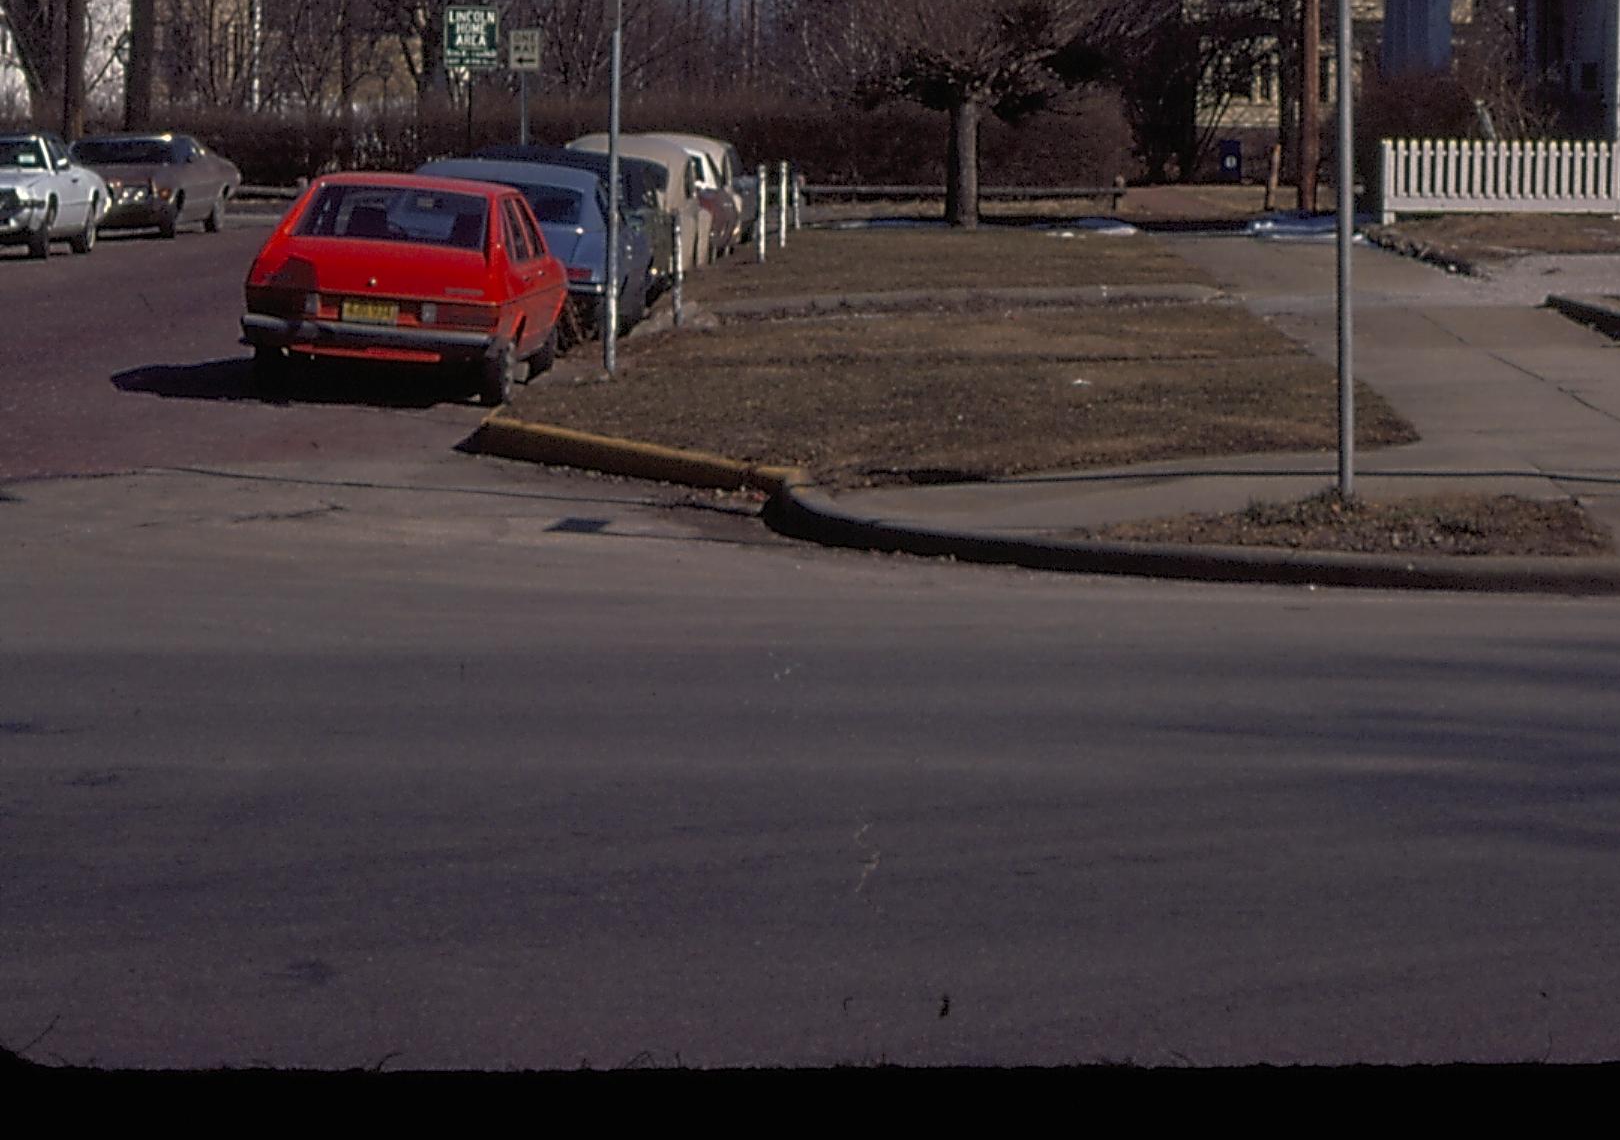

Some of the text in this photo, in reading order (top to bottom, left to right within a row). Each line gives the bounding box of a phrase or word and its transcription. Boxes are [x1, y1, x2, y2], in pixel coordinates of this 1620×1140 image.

[448, 10, 496, 23] LINCOLN
[456, 23, 487, 34] HOME
[455, 34, 486, 46] AREA
[512, 30, 536, 42] ONE
